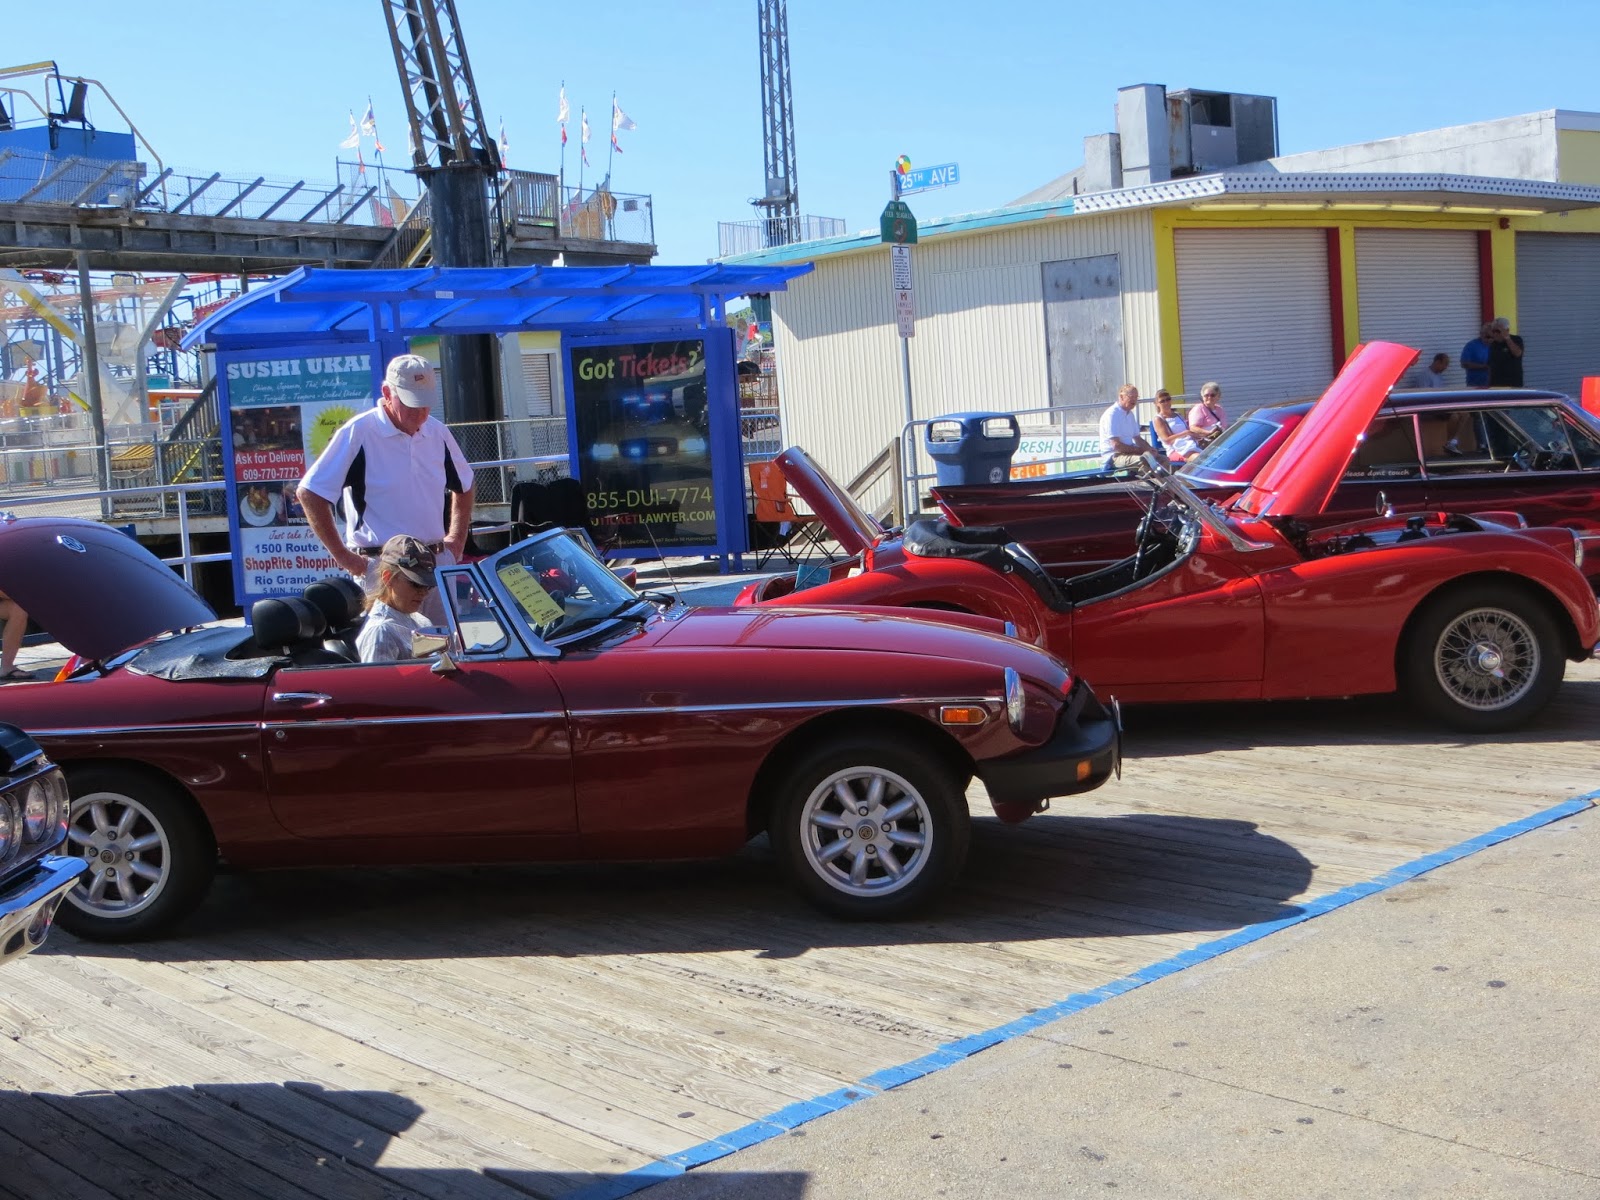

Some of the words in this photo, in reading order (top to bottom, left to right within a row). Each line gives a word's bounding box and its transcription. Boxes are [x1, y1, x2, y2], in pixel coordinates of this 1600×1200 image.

[901, 173, 923, 190] 25TH
[931, 166, 956, 185] AVE
[227, 360, 301, 380] SUSHI
[307, 355, 371, 373] UKAI
[579, 358, 615, 381] Got
[619, 351, 698, 378] Tickets?
[1019, 440, 1053, 454] RESH
[1055, 440, 1101, 454] SQUEE
[235, 453, 252, 465] Ask
[254, 452, 267, 464] for
[268, 450, 304, 466] Delivery
[242, 467, 300, 480] 609-770-7773
[587, 487, 712, 509] 855-DUI-7774
[269, 529, 284, 540] Just
[286, 530, 302, 539] take
[255, 543, 282, 554] 1500
[286, 543, 319, 553] Route
[245, 556, 293, 573] ShopRite
[255, 575, 273, 585] Rio
[290, 586, 305, 594] fro
